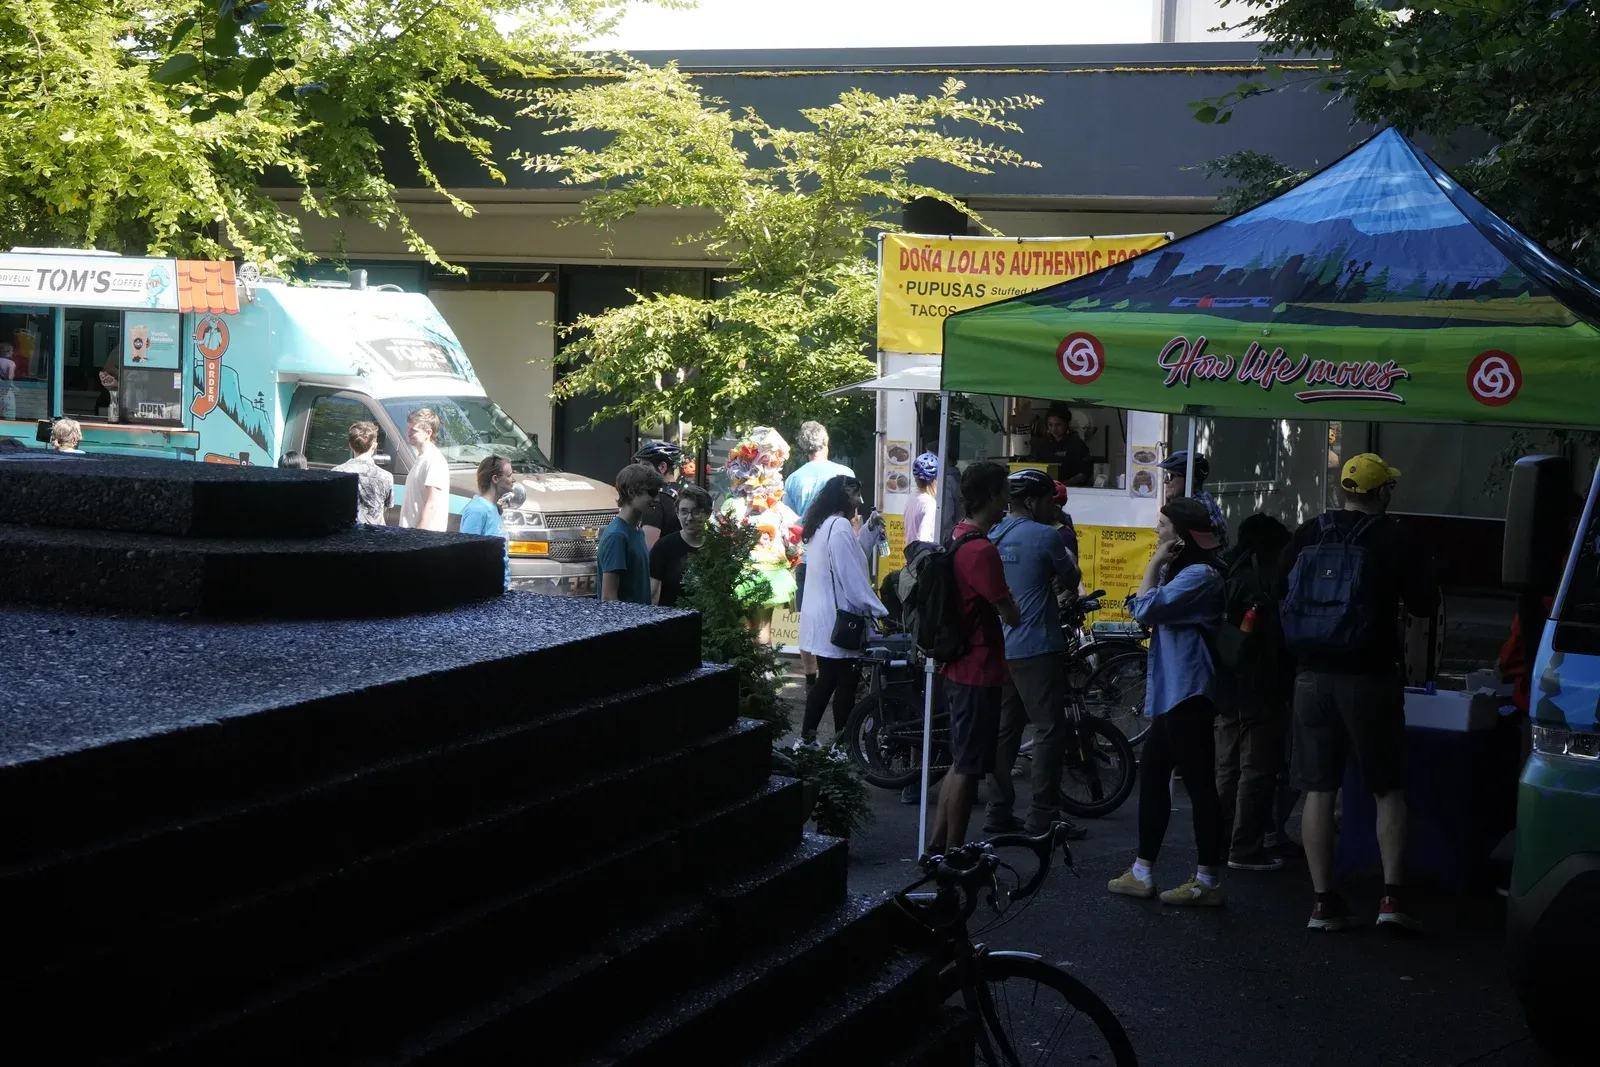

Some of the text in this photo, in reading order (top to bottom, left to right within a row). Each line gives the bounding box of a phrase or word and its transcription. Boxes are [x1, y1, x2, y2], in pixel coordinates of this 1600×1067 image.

[899, 244, 942, 272] DOÑA
[947, 250, 1006, 275] LOLA'S
[1009, 250, 1103, 276] AUTHENTIC
[36, 268, 112, 294] TOM'S
[112, 278, 143, 287] COFFEE
[906, 280, 986, 298] PUPUSAS
[990, 286, 1027, 296] Stuffed
[909, 303, 957, 318] TACOS
[1158, 335, 1410, 391] How life moves
[208, 362, 216, 403] ORDER
[140, 403, 165, 418] OPEN
[889, 520, 905, 530] PUPU
[1102, 530, 1136, 541] SIDE ORDERS
[769, 627, 800, 640] RANC
